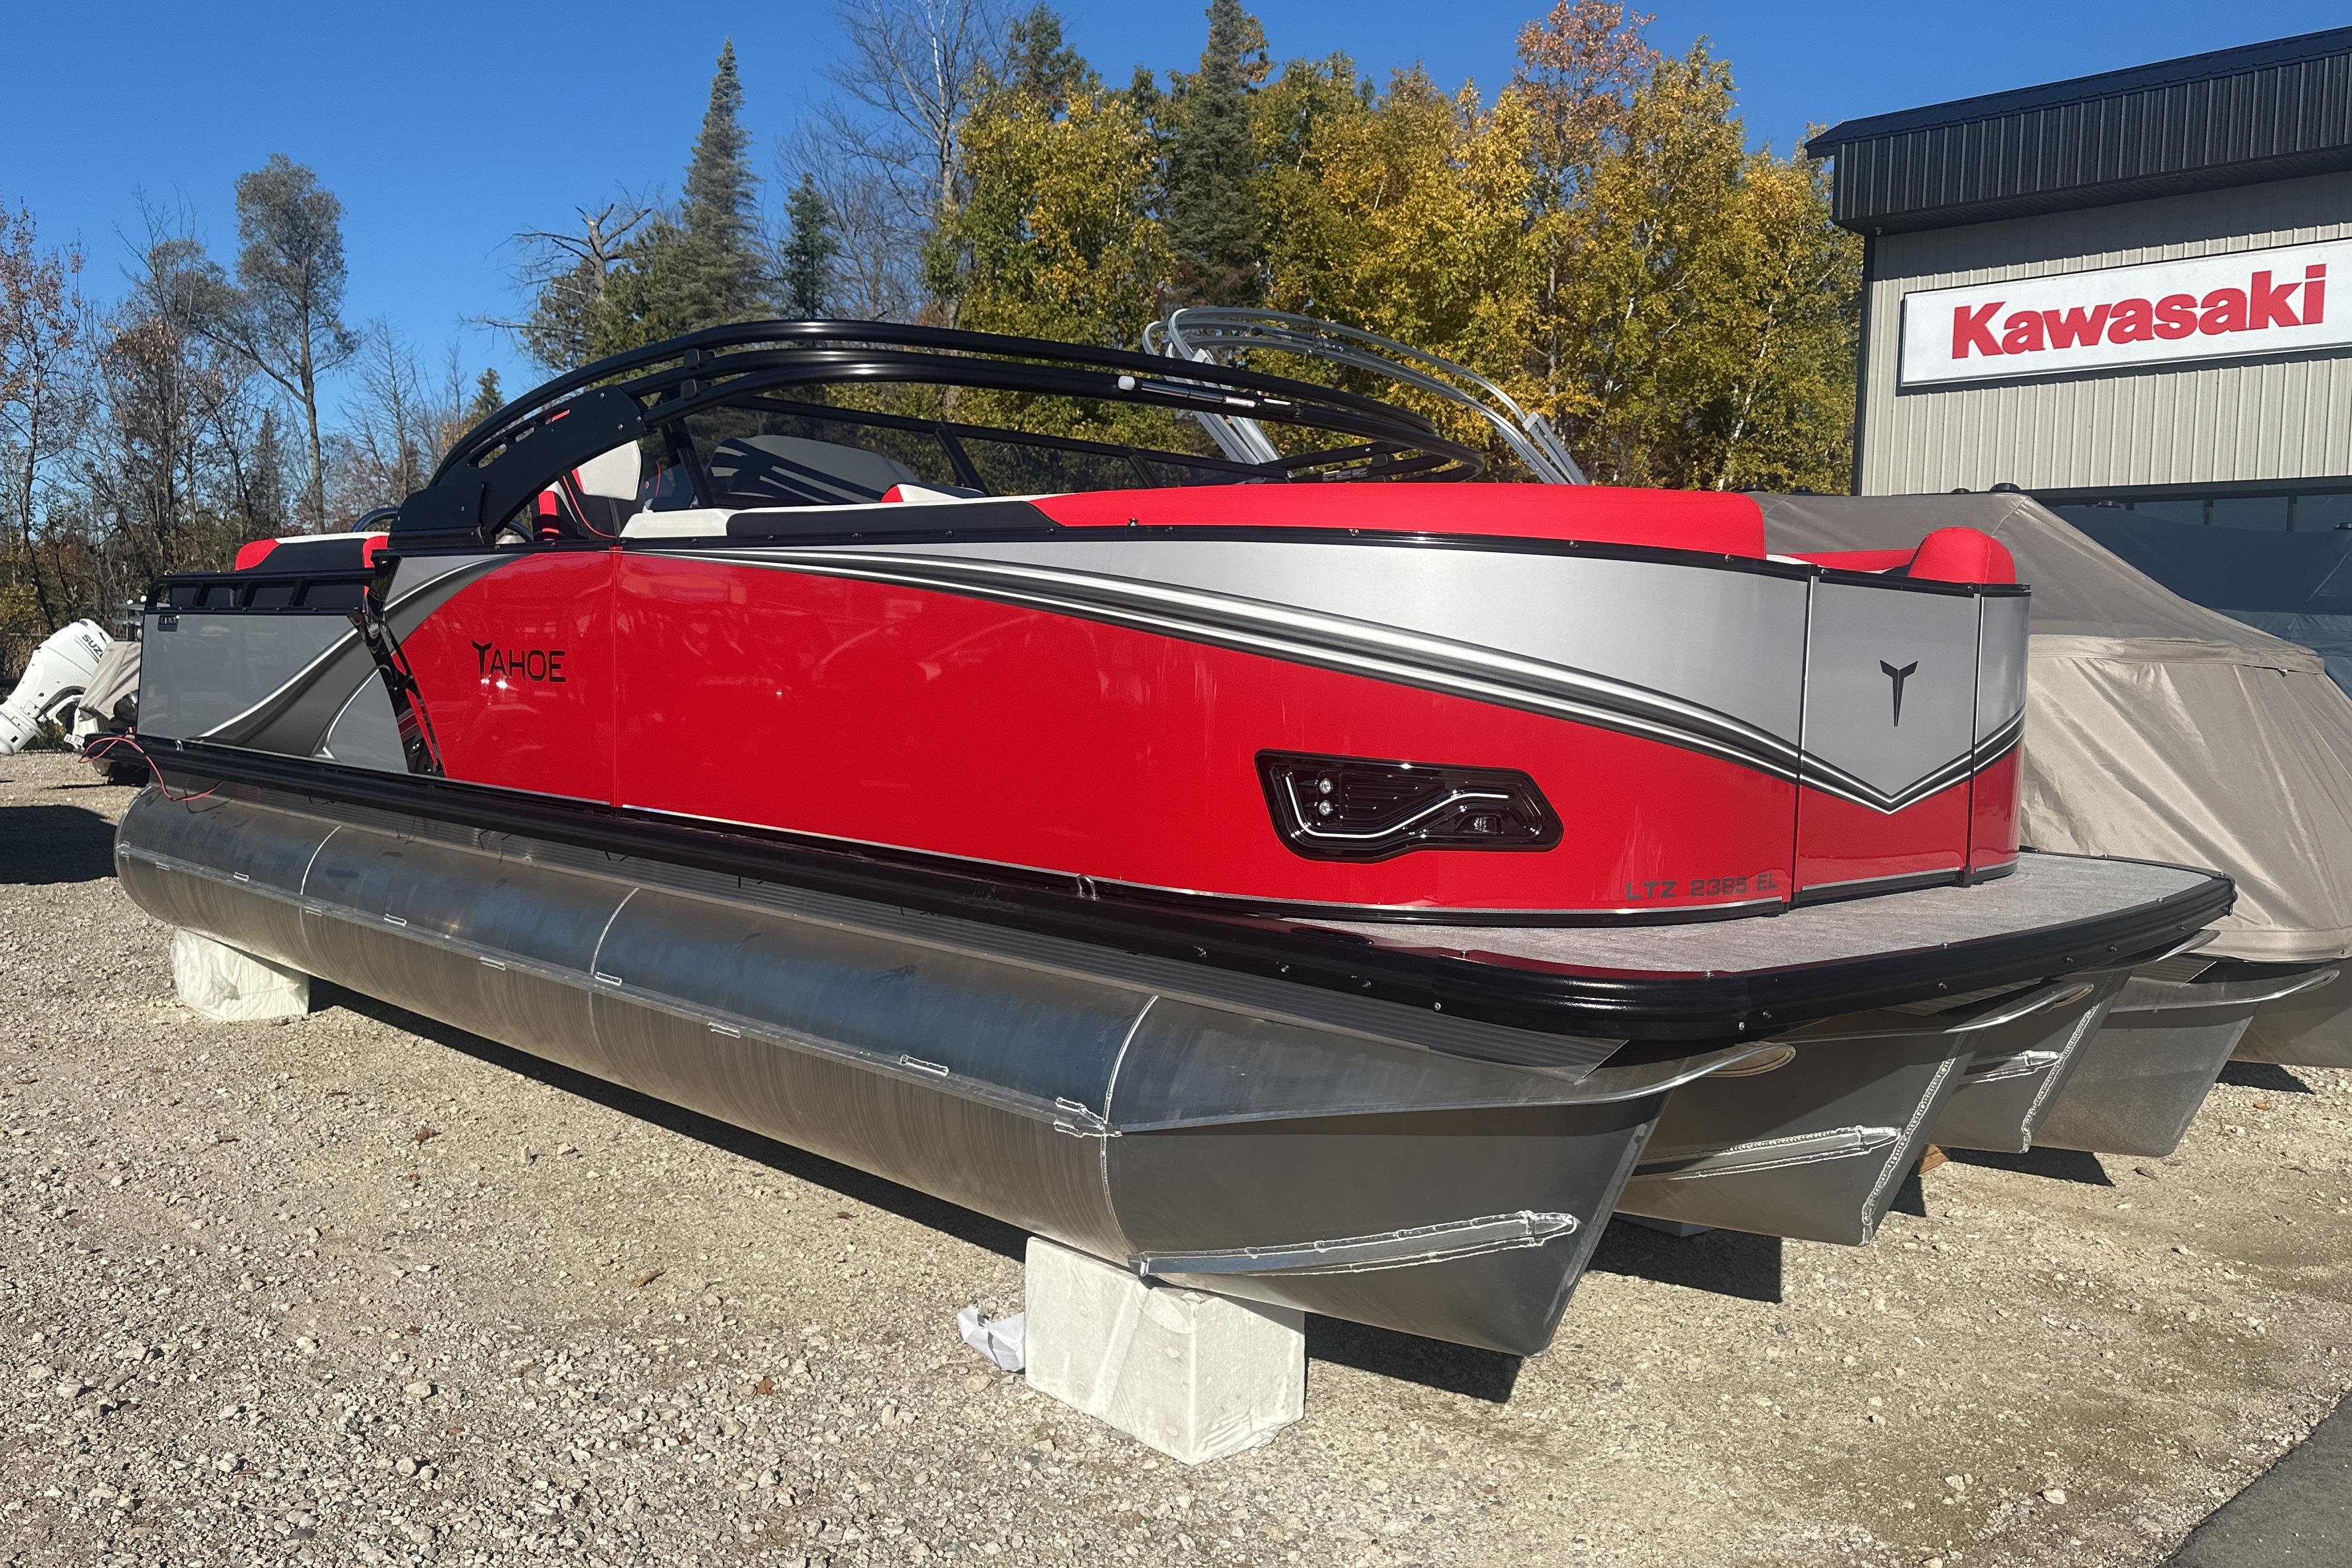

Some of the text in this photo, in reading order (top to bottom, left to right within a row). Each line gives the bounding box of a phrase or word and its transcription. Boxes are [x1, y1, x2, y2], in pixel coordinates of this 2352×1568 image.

[1952, 264, 2327, 359] Kawasaki
[82, 634, 103, 658] SUZ
[472, 640, 566, 682] TAHOE
[1626, 874, 1777, 900] LTZ 2385 EL
